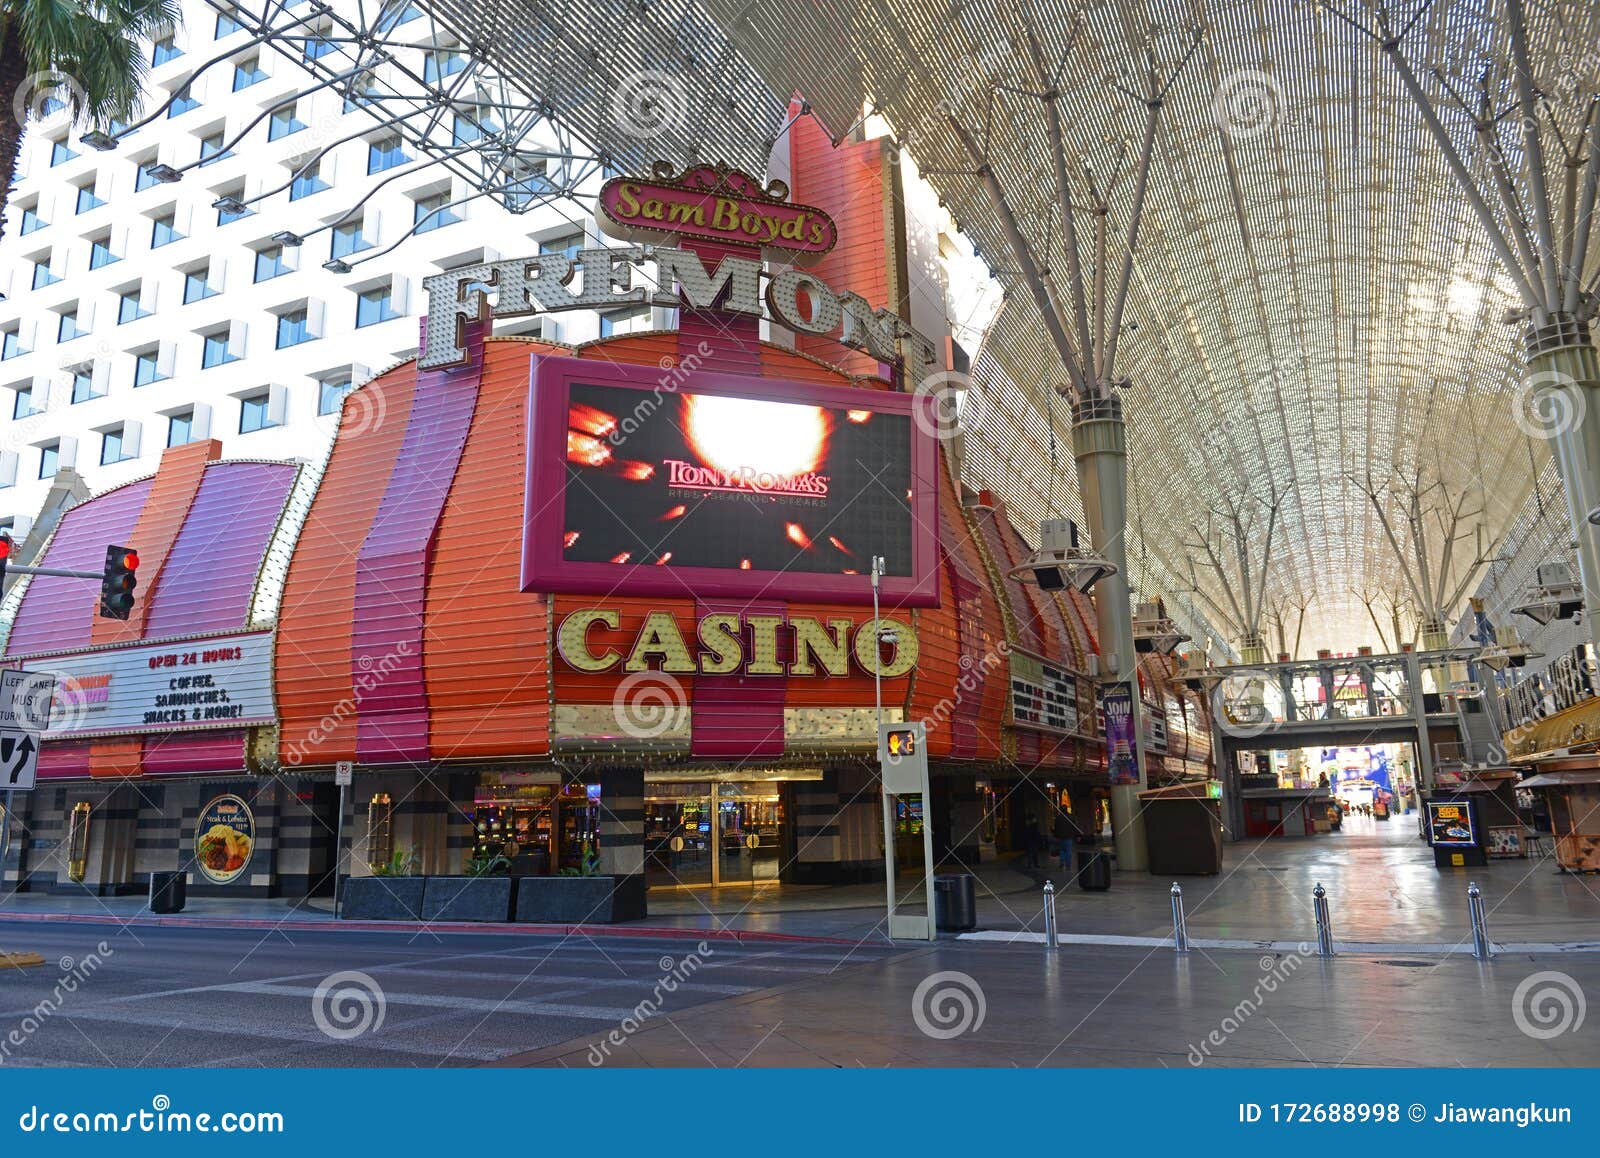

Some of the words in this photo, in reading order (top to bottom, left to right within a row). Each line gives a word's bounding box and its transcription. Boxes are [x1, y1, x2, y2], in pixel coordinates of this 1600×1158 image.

[615, 182, 706, 227] Sam
[710, 198, 825, 244] Boyd's
[418, 247, 936, 386] FREMONT
[557, 608, 919, 678] CASINO
[148, 654, 178, 669] OPEN
[181, 652, 197, 665] 24
[202, 646, 242, 663] HOURS
[5, 677, 24, 687] LEFT
[29, 679, 49, 689] LANE
[11, 694, 39, 706] MUST
[1106, 700, 1131, 716] JOIN
[0, 711, 21, 721] TURN
[143, 709, 187, 724] SNACKS
[192, 707, 201, 720] &
[204, 704, 243, 719] MORE!
[1111, 714, 1129, 725] THE
